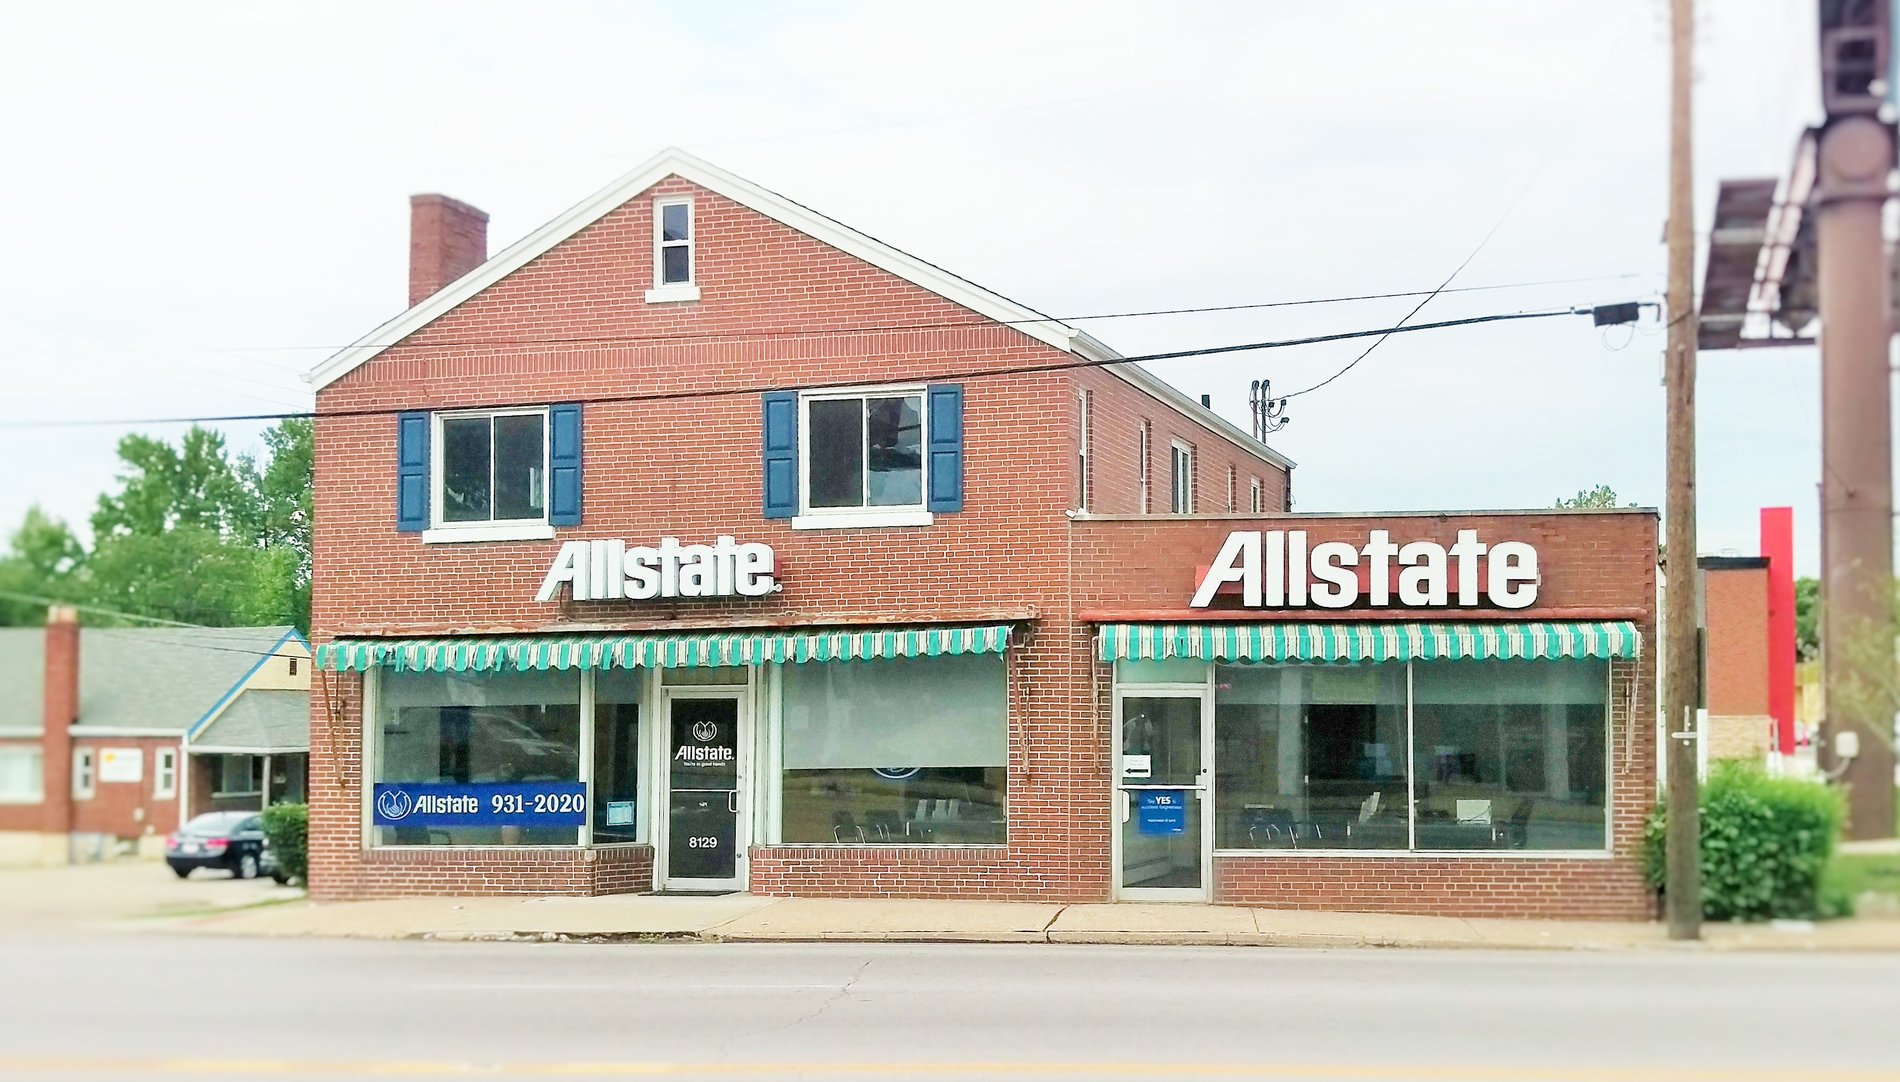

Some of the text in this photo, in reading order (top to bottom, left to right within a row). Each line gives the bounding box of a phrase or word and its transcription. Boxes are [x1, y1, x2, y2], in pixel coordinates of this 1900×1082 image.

[1189, 529, 1539, 608] Allstate
[412, 793, 585, 814] Allstate 931-2020
[1155, 796, 1172, 805] YES
[689, 836, 718, 848] 8129
